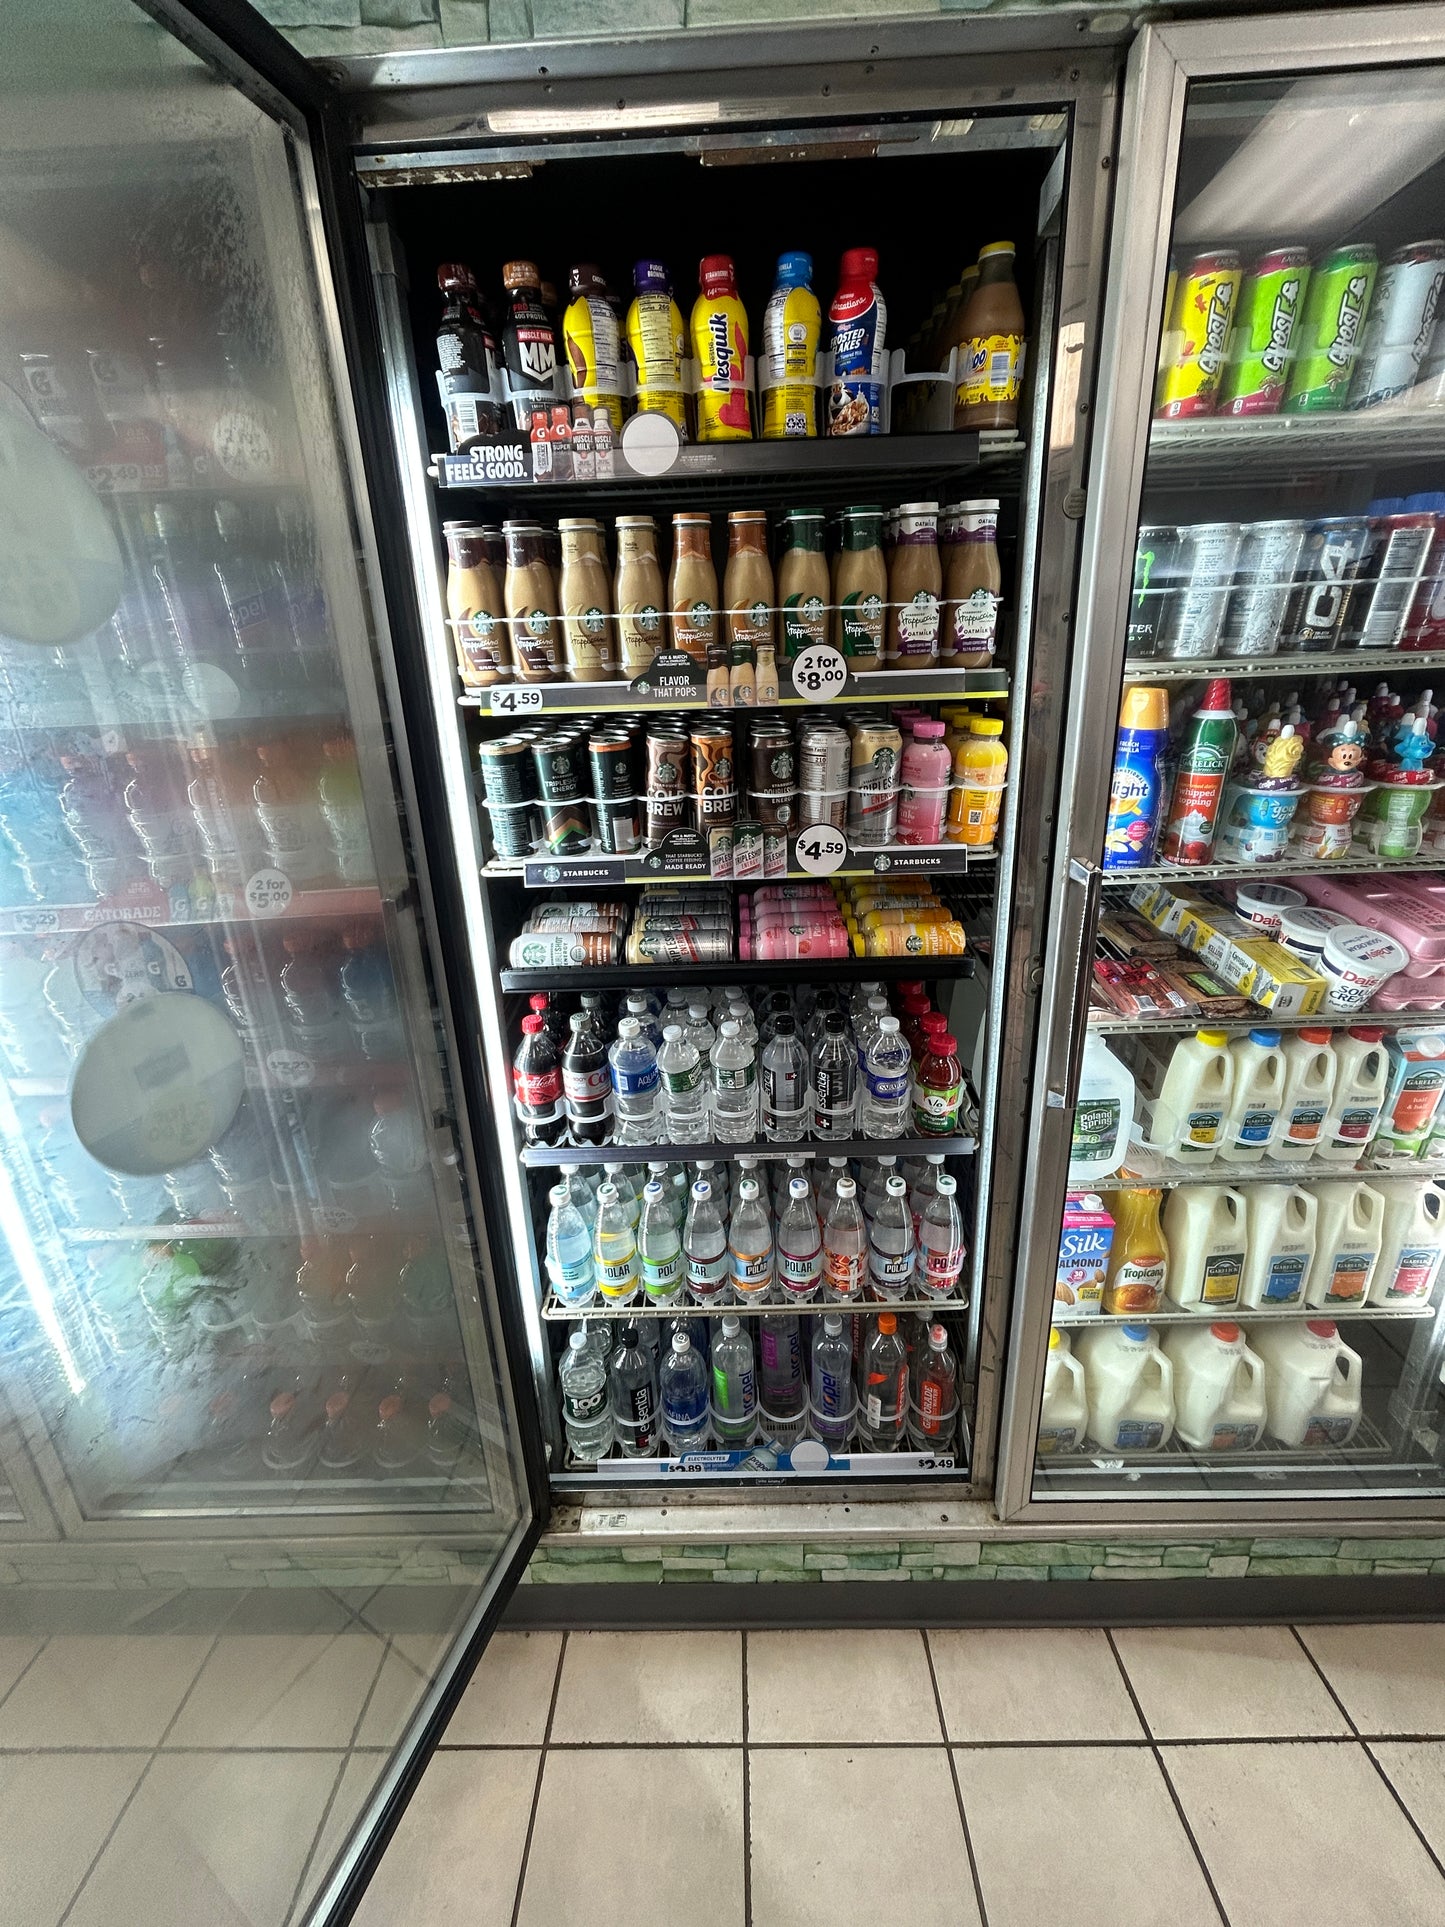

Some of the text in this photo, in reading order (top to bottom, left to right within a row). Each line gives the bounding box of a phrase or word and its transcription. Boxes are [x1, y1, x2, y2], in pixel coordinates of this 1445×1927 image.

[519, 330, 553, 341] MUSCLE MILK
[713, 312, 734, 393] Nesquik
[536, 428, 546, 438] G
[556, 425, 566, 435] G
[470, 444, 524, 464] STRONG
[446, 461, 528, 482] FEELS GOOD.
[907, 629, 933, 638] OATMILK
[962, 627, 989, 637] OATMILK
[803, 654, 839, 669] 2 for
[659, 675, 690, 686] FLAVOR
[797, 670, 844, 691] $8.00
[653, 686, 697, 698] THAT POPS
[492, 690, 540, 712] $4.59
[1179, 788, 1216, 802] whipped
[646, 801, 684, 817] BREW
[797, 840, 845, 861] $4.59
[893, 857, 941, 870] STARBUCKS
[562, 869, 610, 881] STARBUCKS
[255, 878, 285, 891] 2 for
[84, 905, 161, 922] GATORADE
[1080, 1108, 1113, 1123] Poland
[1080, 1118, 1113, 1132] Spring
[1060, 1231, 1108, 1258] Silk
[603, 1264, 631, 1279] POLAR
[746, 1262, 769, 1276] POLAR
[785, 1261, 813, 1275] POLAR
[886, 1262, 909, 1275] POLAR
[1059, 1259, 1104, 1273] ALMOND
[1123, 1268, 1165, 1283] Tropicana
[922, 1384, 933, 1430] GATORADE
